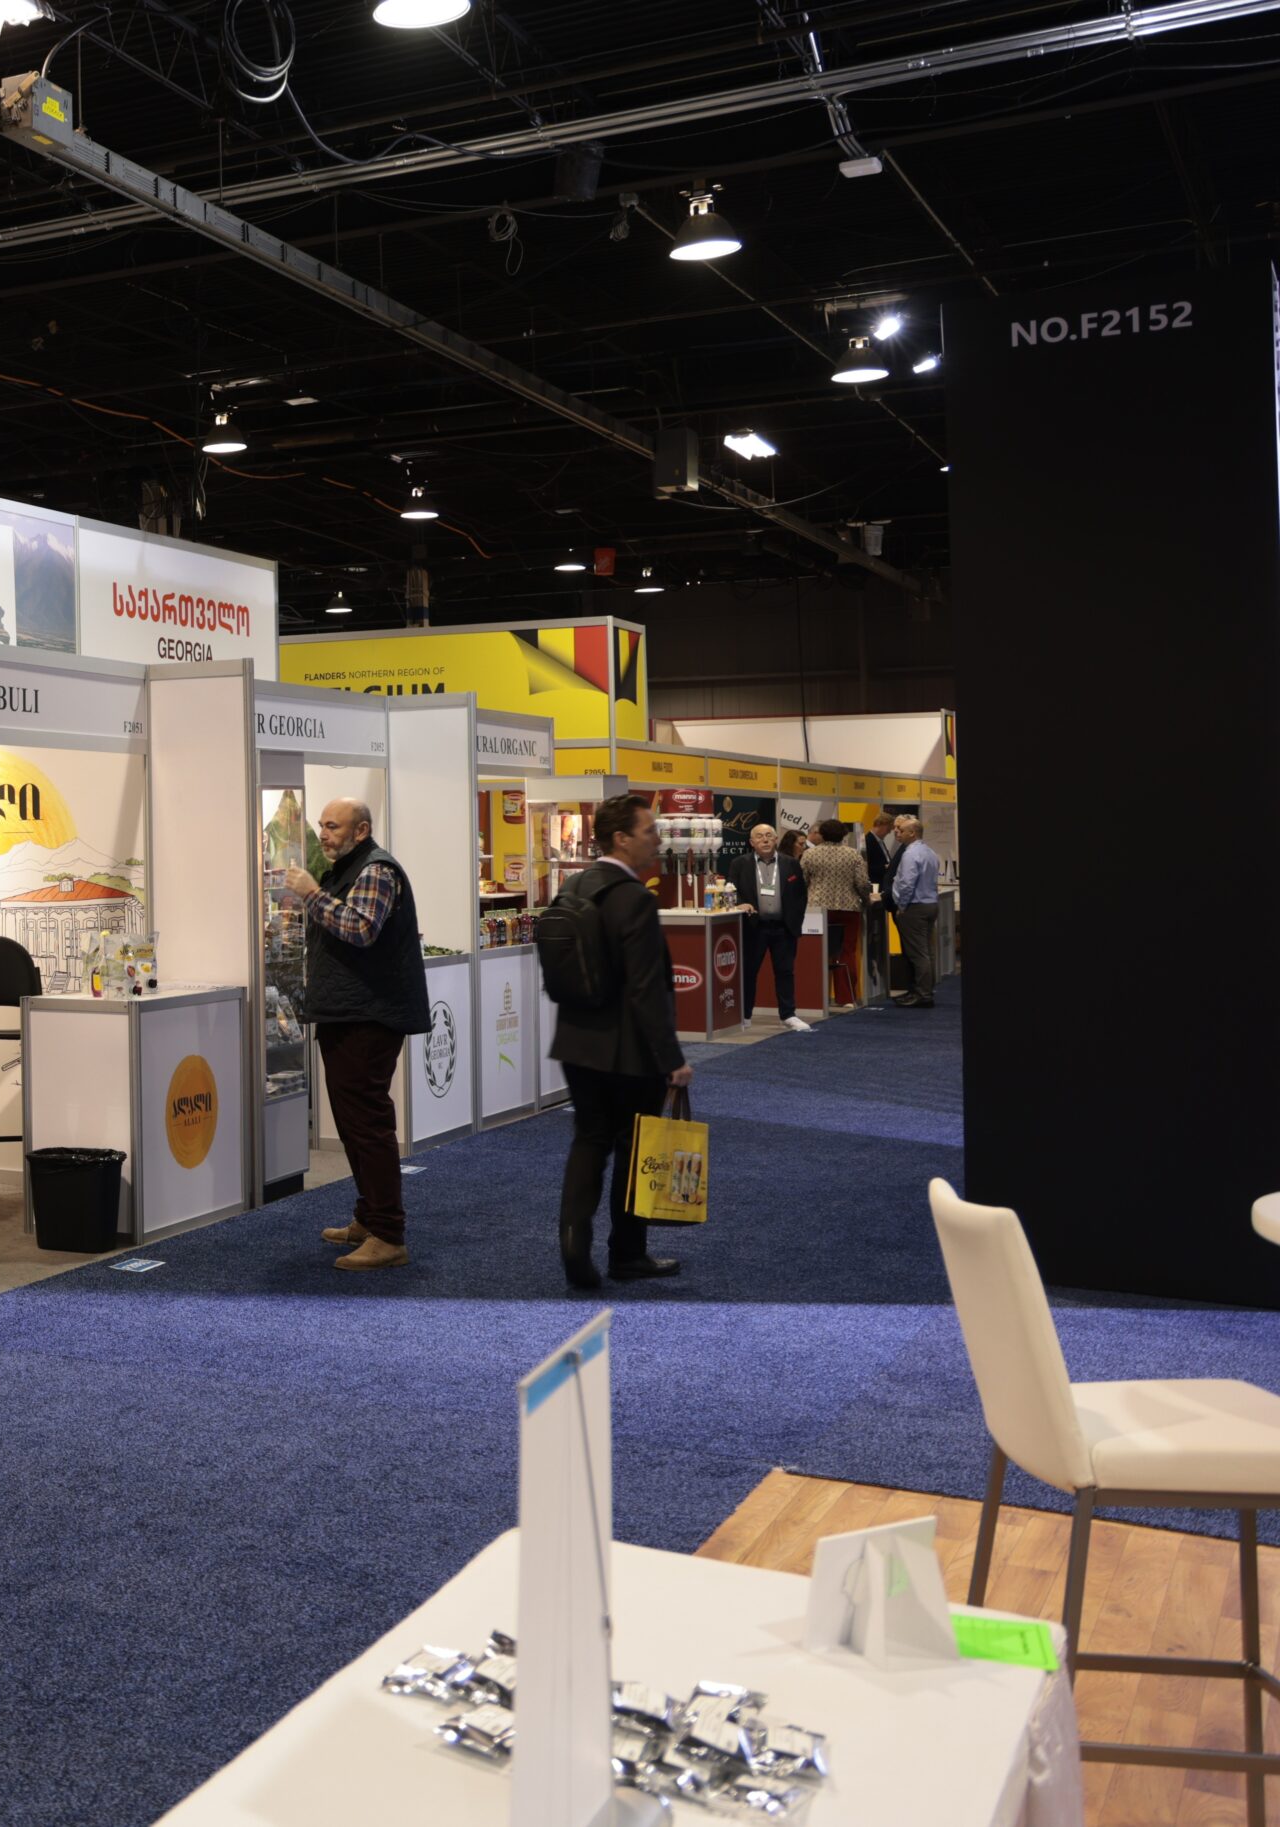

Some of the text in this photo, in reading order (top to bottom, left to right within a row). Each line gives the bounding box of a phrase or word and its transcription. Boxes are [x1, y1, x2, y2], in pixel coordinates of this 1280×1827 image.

[1010, 300, 1193, 348] NO.F2152
[112, 581, 250, 638] საქართველო
[157, 637, 213, 663] GEORGIA
[304, 667, 445, 681] FLANDERS NORTHERN REGION OF
[269, 714, 326, 739] GEORGIA
[476, 735, 537, 757] URAL ORGANIC
[780, 808, 802, 826] hed
[432, 1033, 448, 1049] LAVR
[430, 1048, 451, 1061] GEORGIA
